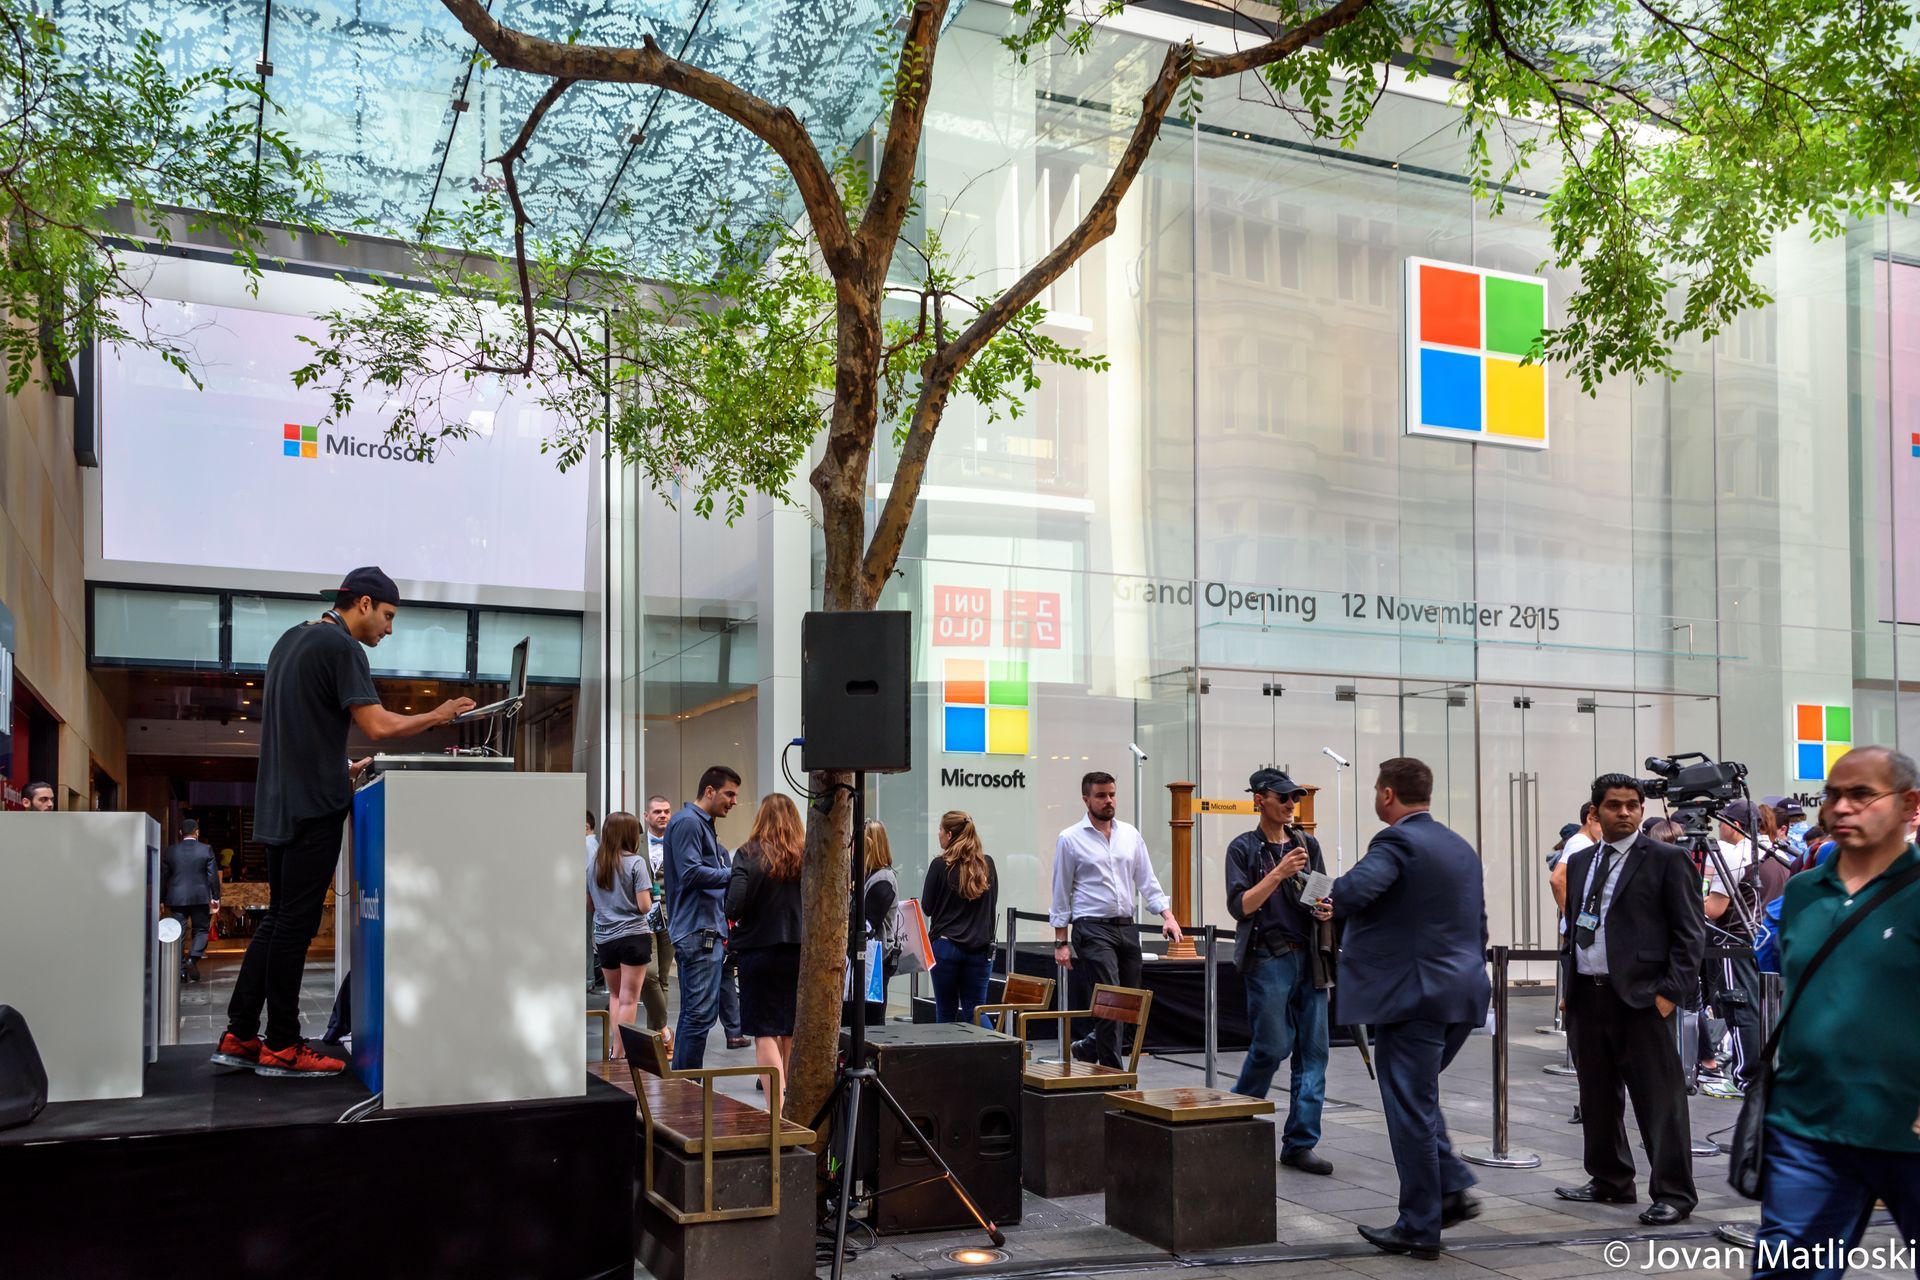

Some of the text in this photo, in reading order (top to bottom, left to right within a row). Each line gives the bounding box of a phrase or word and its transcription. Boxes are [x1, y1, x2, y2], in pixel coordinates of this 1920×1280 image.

[1114, 577, 1560, 631] Grand Opening 12 November 2015
[941, 768, 1026, 788] Microsoft
[1210, 803, 1237, 811] Microsoft
